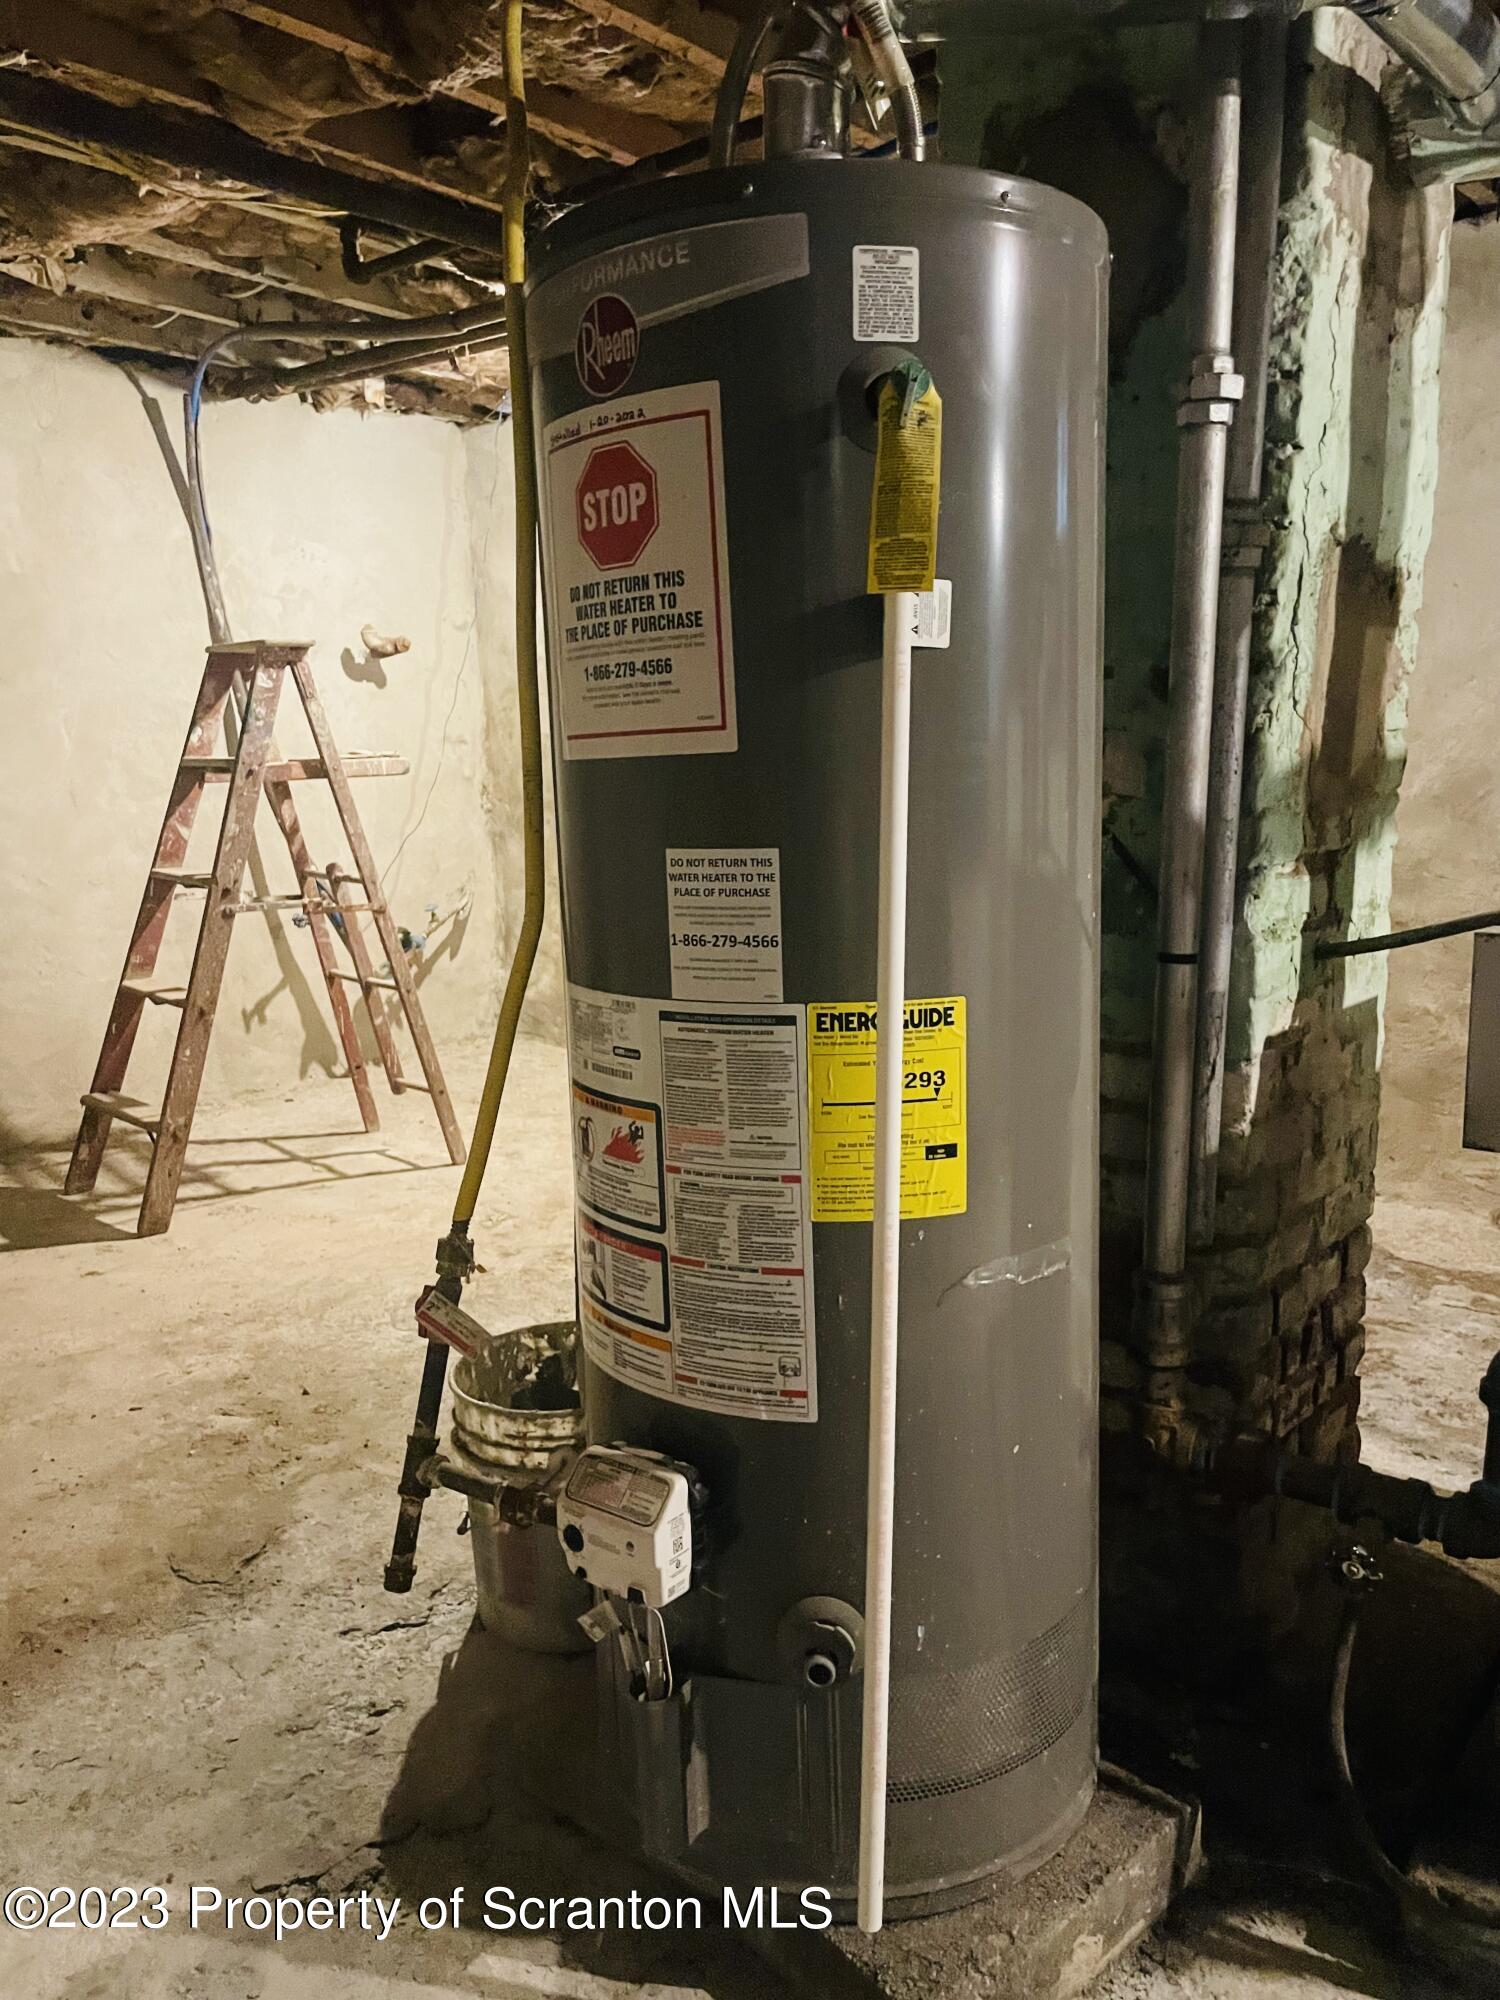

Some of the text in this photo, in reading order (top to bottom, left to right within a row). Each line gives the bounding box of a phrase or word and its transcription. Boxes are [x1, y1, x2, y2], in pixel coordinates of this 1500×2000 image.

[582, 302, 635, 382] Rheem
[583, 482, 648, 532] STOP
[570, 570, 685, 603] DO NOT RETURN THIS
[576, 592, 677, 622] WATER HEATER TO
[566, 611, 703, 643] THE PLACE OF PURCHASE
[584, 657, 673, 682] 1-866-279-4566
[670, 858, 773, 868] DO NOT RETURN THIS
[668, 873, 776, 882] WATER HEATER TO THE
[674, 887, 771, 897] PLACE OF PURCHASE
[671, 933, 779, 948] 1-866-279-4566
